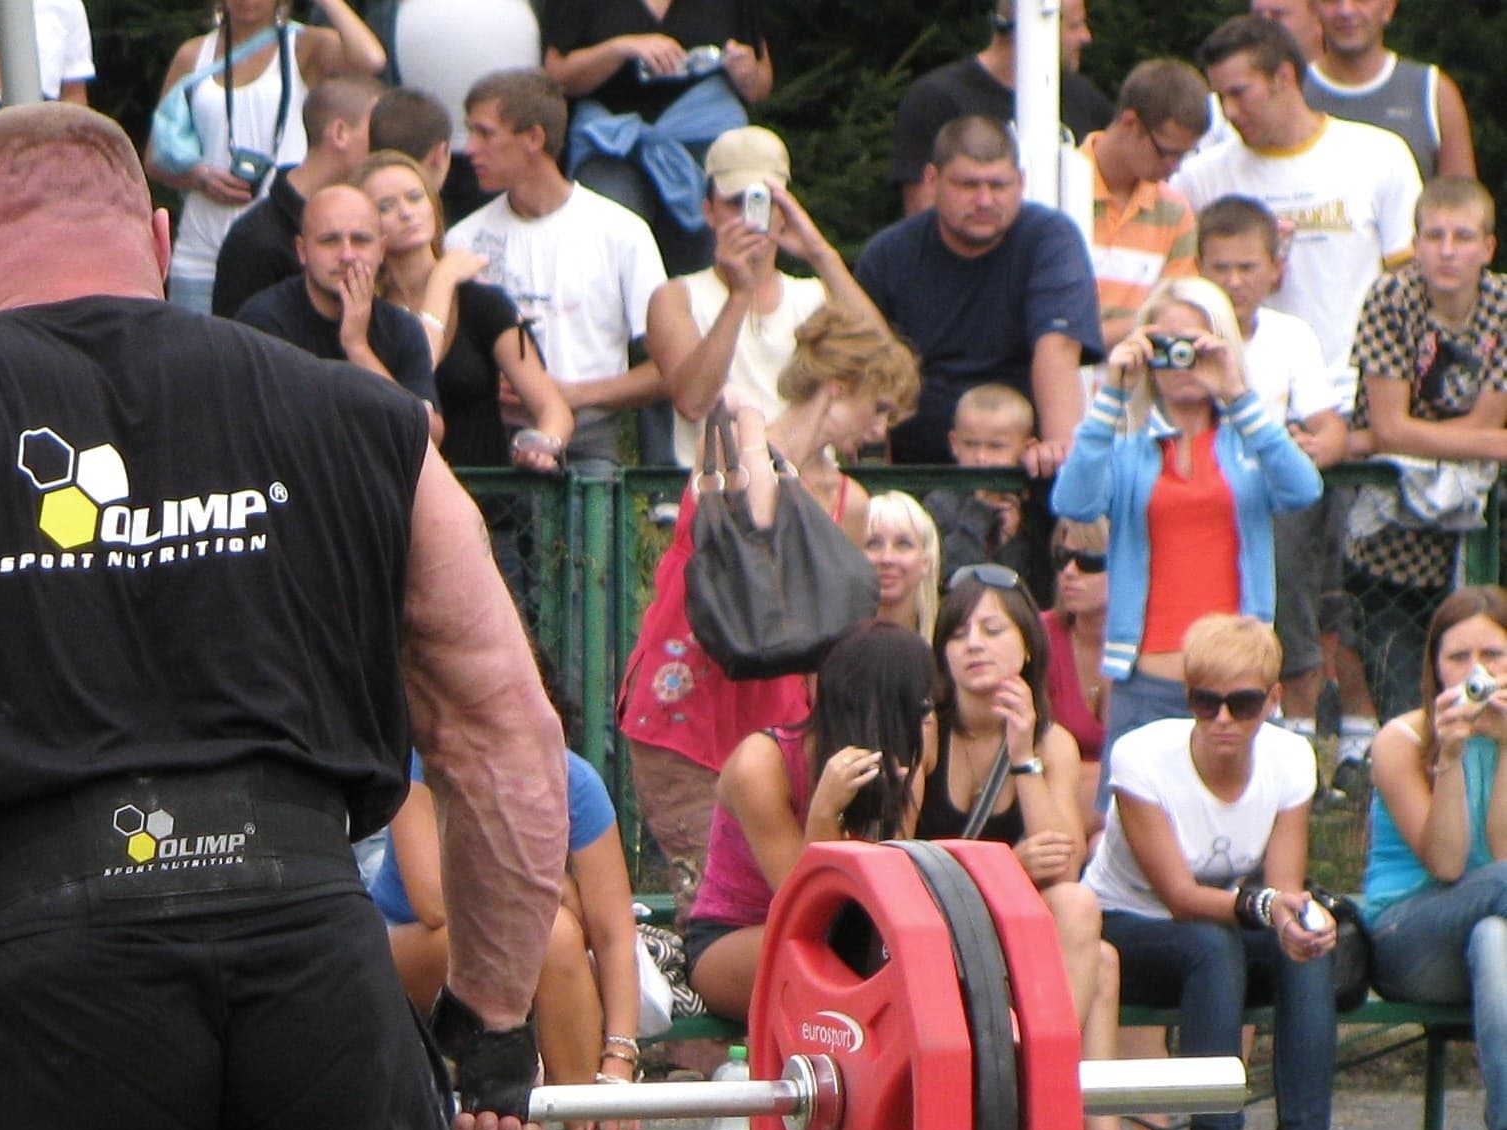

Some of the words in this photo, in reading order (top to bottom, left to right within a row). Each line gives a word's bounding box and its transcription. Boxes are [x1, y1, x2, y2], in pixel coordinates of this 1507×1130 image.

[0, 552, 95, 573] SPORT
[107, 534, 267, 569] NUTRITION
[103, 863, 155, 877] SPORT
[160, 856, 244, 871] NUTRITION
[801, 1021, 852, 1053] eurosport
